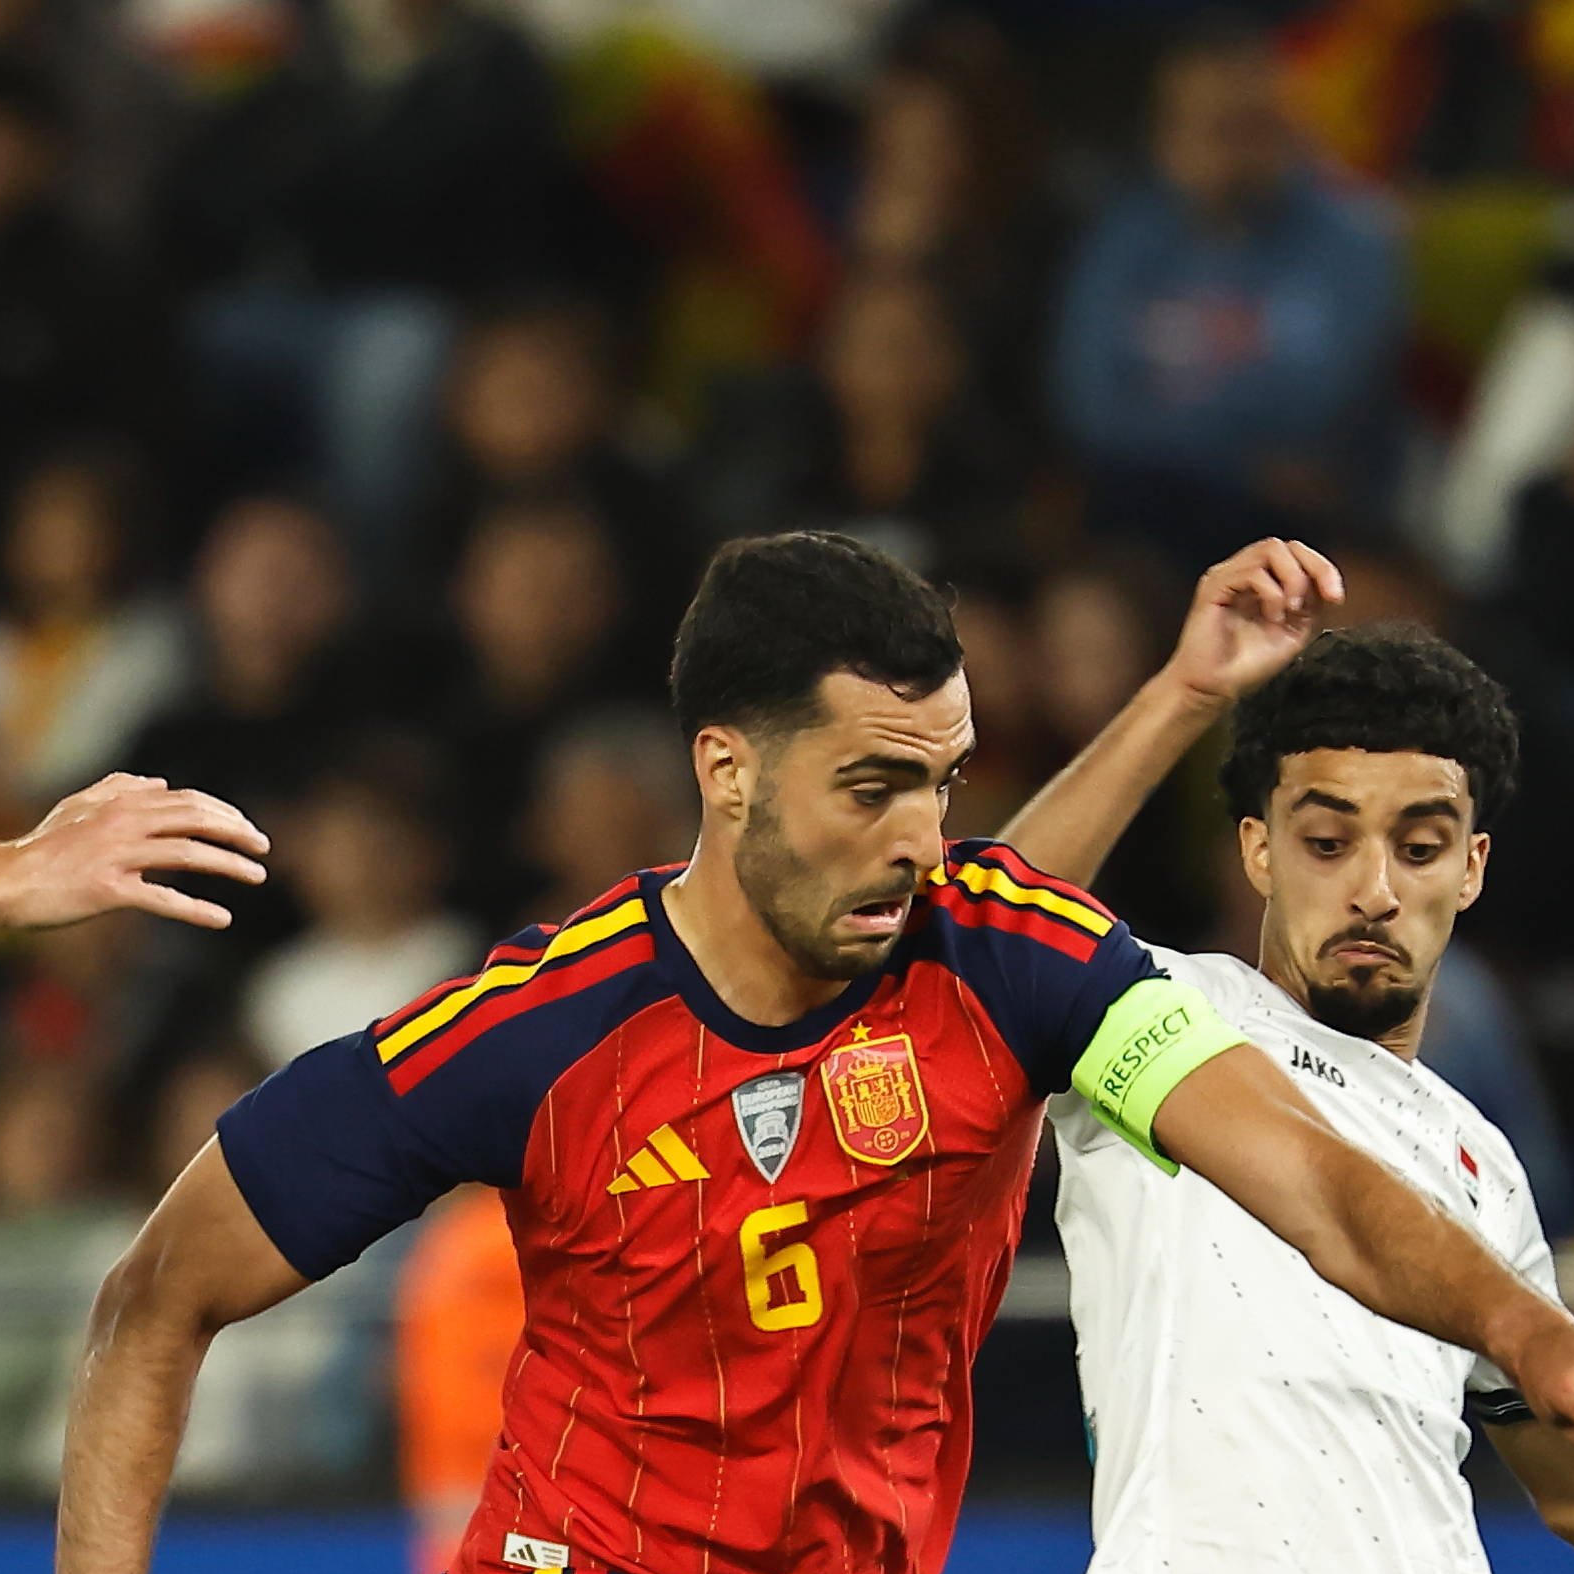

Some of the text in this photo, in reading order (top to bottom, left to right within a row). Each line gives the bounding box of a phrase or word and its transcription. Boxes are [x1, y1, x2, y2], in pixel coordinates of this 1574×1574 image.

[1103, 1005, 1191, 1099] RESPECT
[1290, 1045, 1345, 1089] JAKO
[738, 1200, 824, 1332] 6
